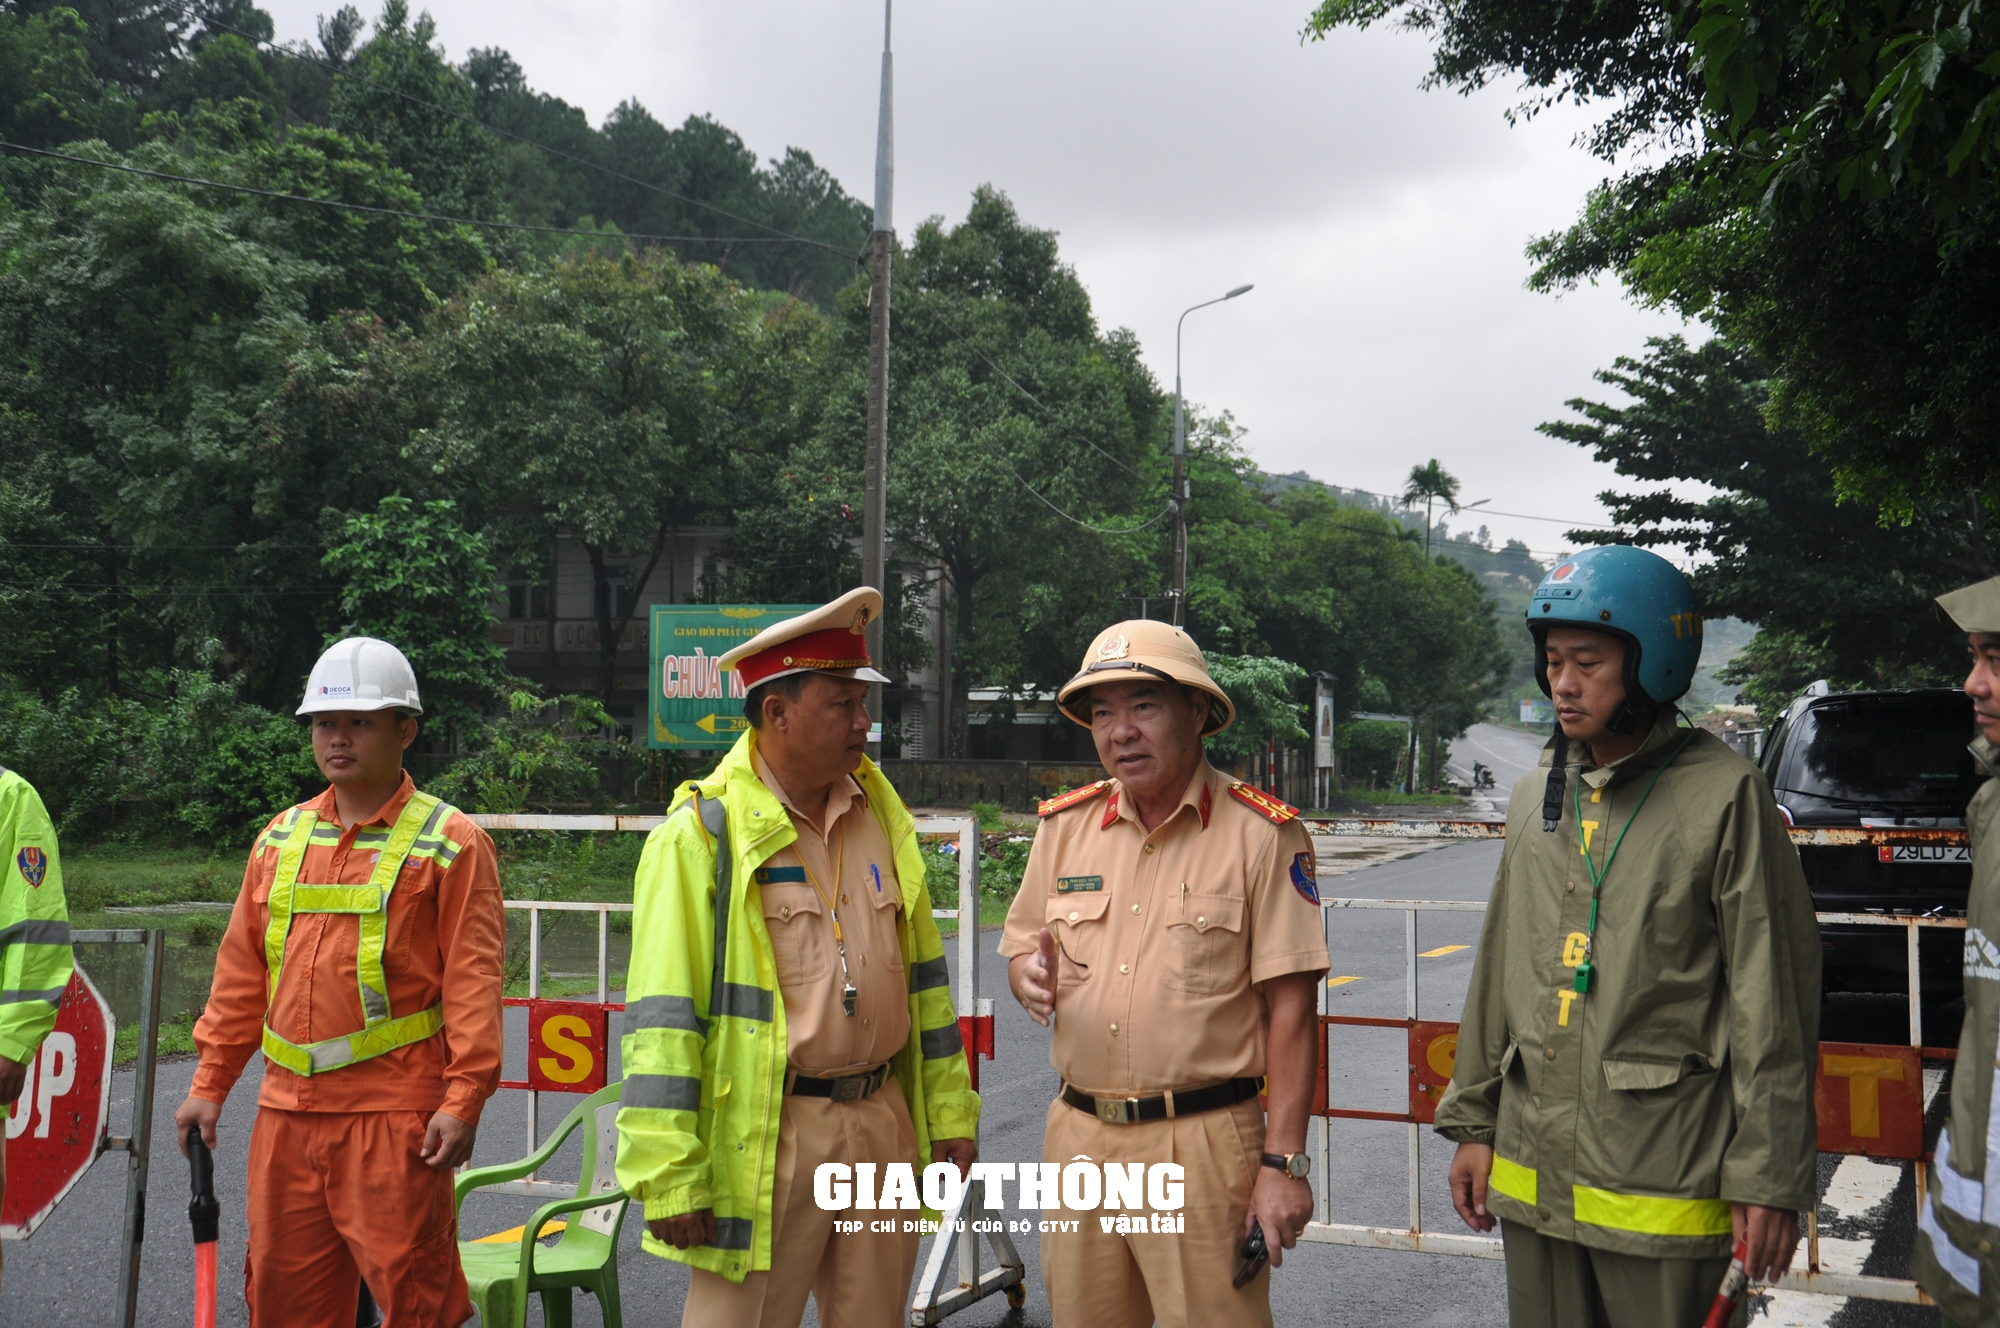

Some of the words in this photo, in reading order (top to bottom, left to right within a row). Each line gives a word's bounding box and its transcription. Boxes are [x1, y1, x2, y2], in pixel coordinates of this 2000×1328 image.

[674, 626, 697, 637] GIÁO
[699, 626, 715, 638] HỘI
[663, 647, 723, 699] CHÙA
[728, 669, 749, 699] N
[538, 1014, 594, 1084] S
[1823, 1054, 1904, 1139] T
